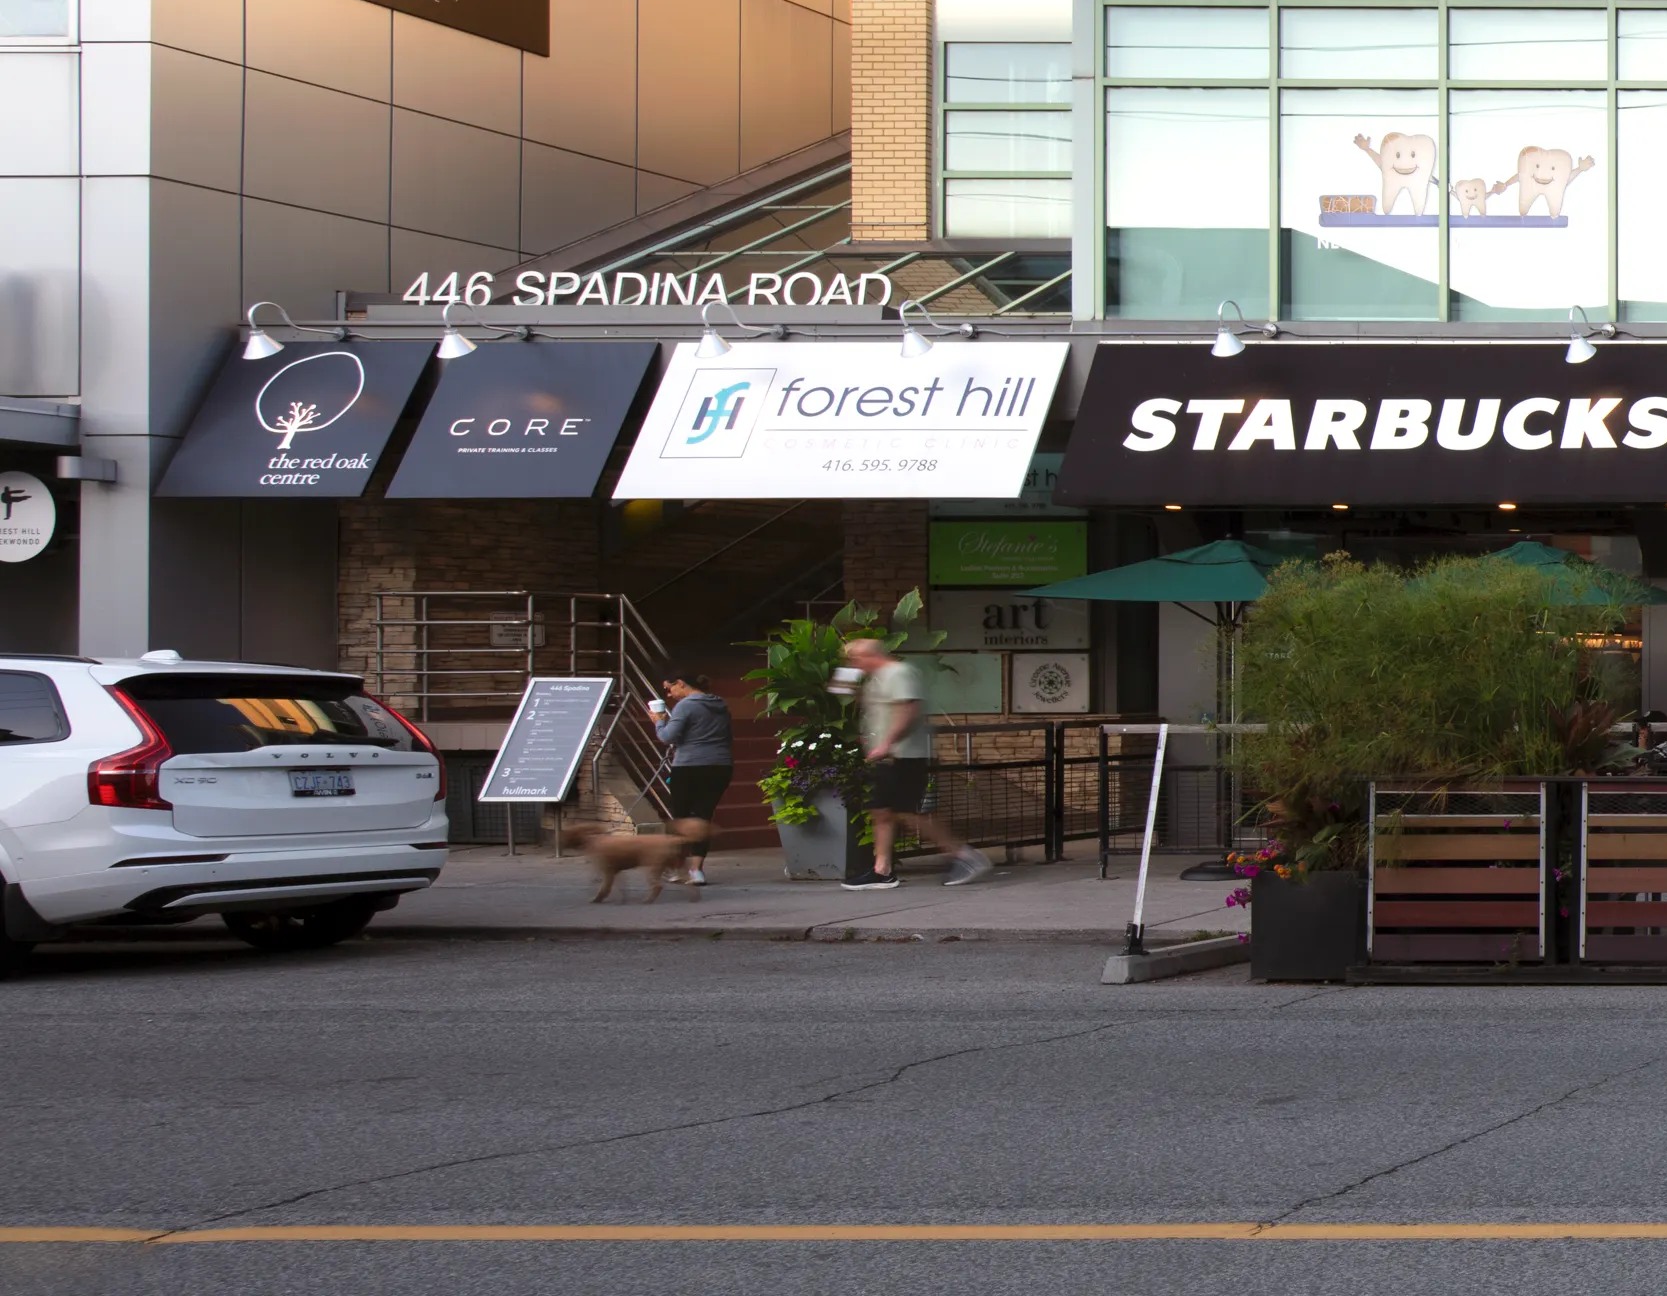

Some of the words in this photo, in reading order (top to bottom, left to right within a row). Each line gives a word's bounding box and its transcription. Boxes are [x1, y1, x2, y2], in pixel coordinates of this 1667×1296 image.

[402, 271, 494, 306] 446
[512, 271, 729, 306] SPADINA
[746, 271, 893, 306] ROAD
[777, 377, 943, 417] forest
[956, 377, 1036, 417] hill
[763, 438, 901, 449] COSMETIC
[925, 438, 1021, 449] CLINIC
[268, 453, 300, 469] the
[300, 453, 335, 469] red
[336, 453, 371, 469] oak
[898, 459, 938, 473] 9788
[259, 472, 320, 485] centre
[22, 527, 40, 535] HILL
[958, 530, 1059, 559] Stefanie's
[983, 596, 1050, 630] art
[984, 631, 1048, 645] interiors
[1033, 691, 1069, 703] Jewellers
[527, 710, 536, 720] 2
[501, 767, 511, 777] 3
[502, 786, 548, 795] hullmark
